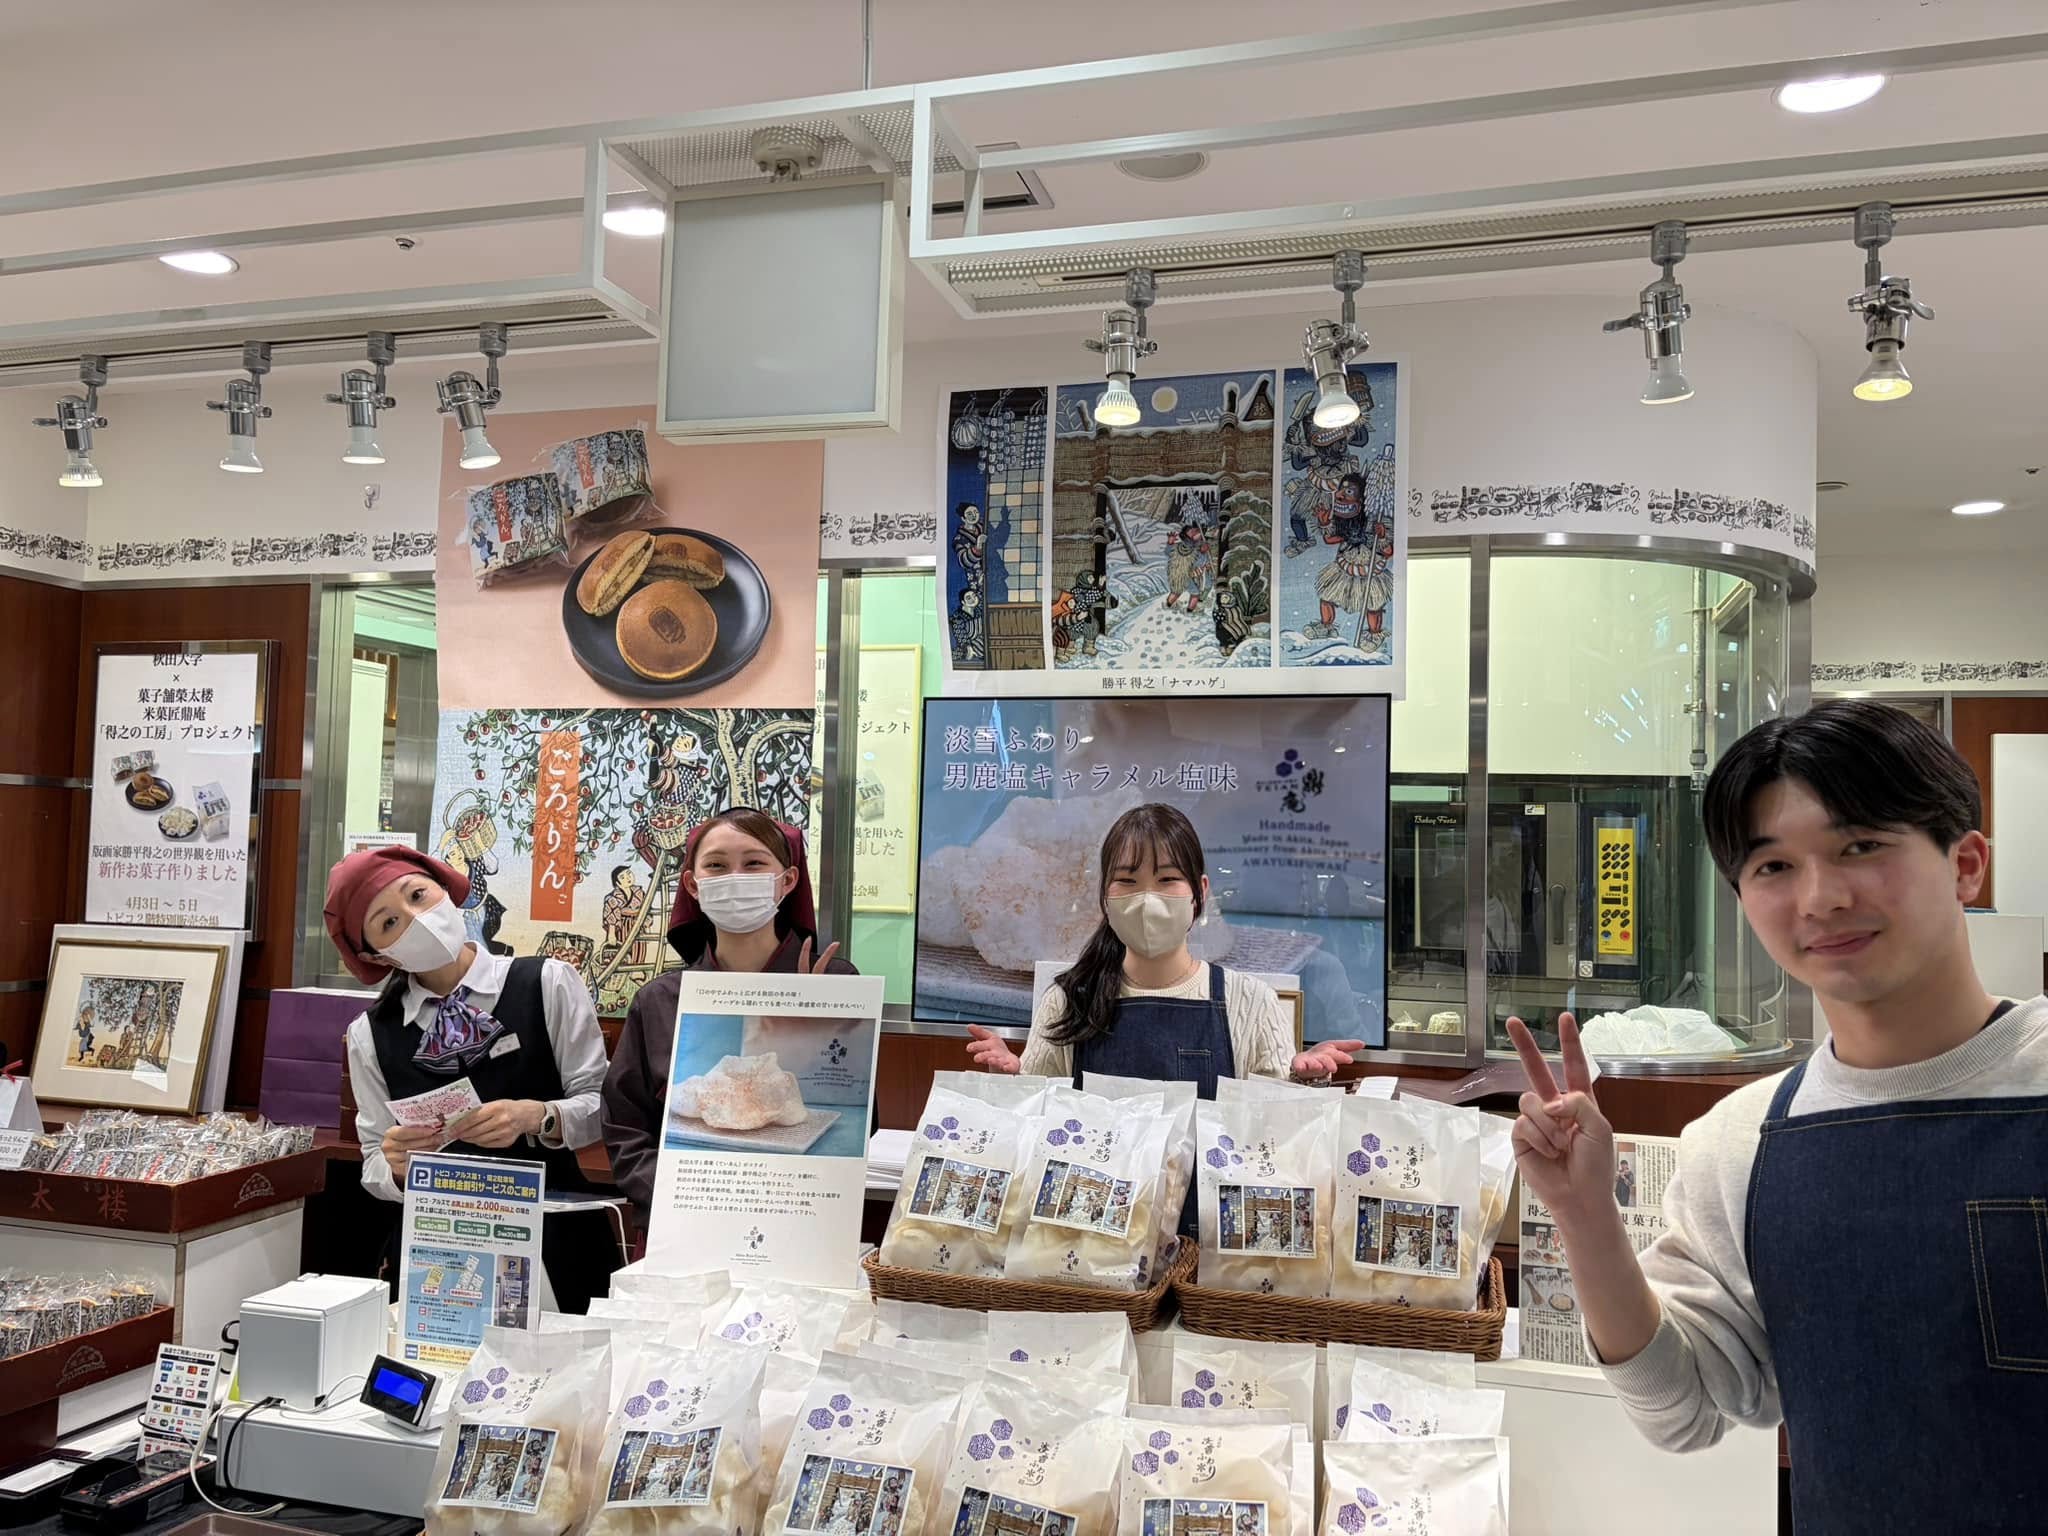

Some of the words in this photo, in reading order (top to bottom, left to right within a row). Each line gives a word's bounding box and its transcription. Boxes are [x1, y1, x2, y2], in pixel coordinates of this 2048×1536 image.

[945, 727, 1081, 753] 淡雪ふわり
[943, 763, 1238, 792] 男鹿塩キャラメル塩味
[1259, 819, 1331, 833] Handmade
[98, 862, 238, 881] 新作お菓子作りました
[415, 1169, 429, 1184] P
